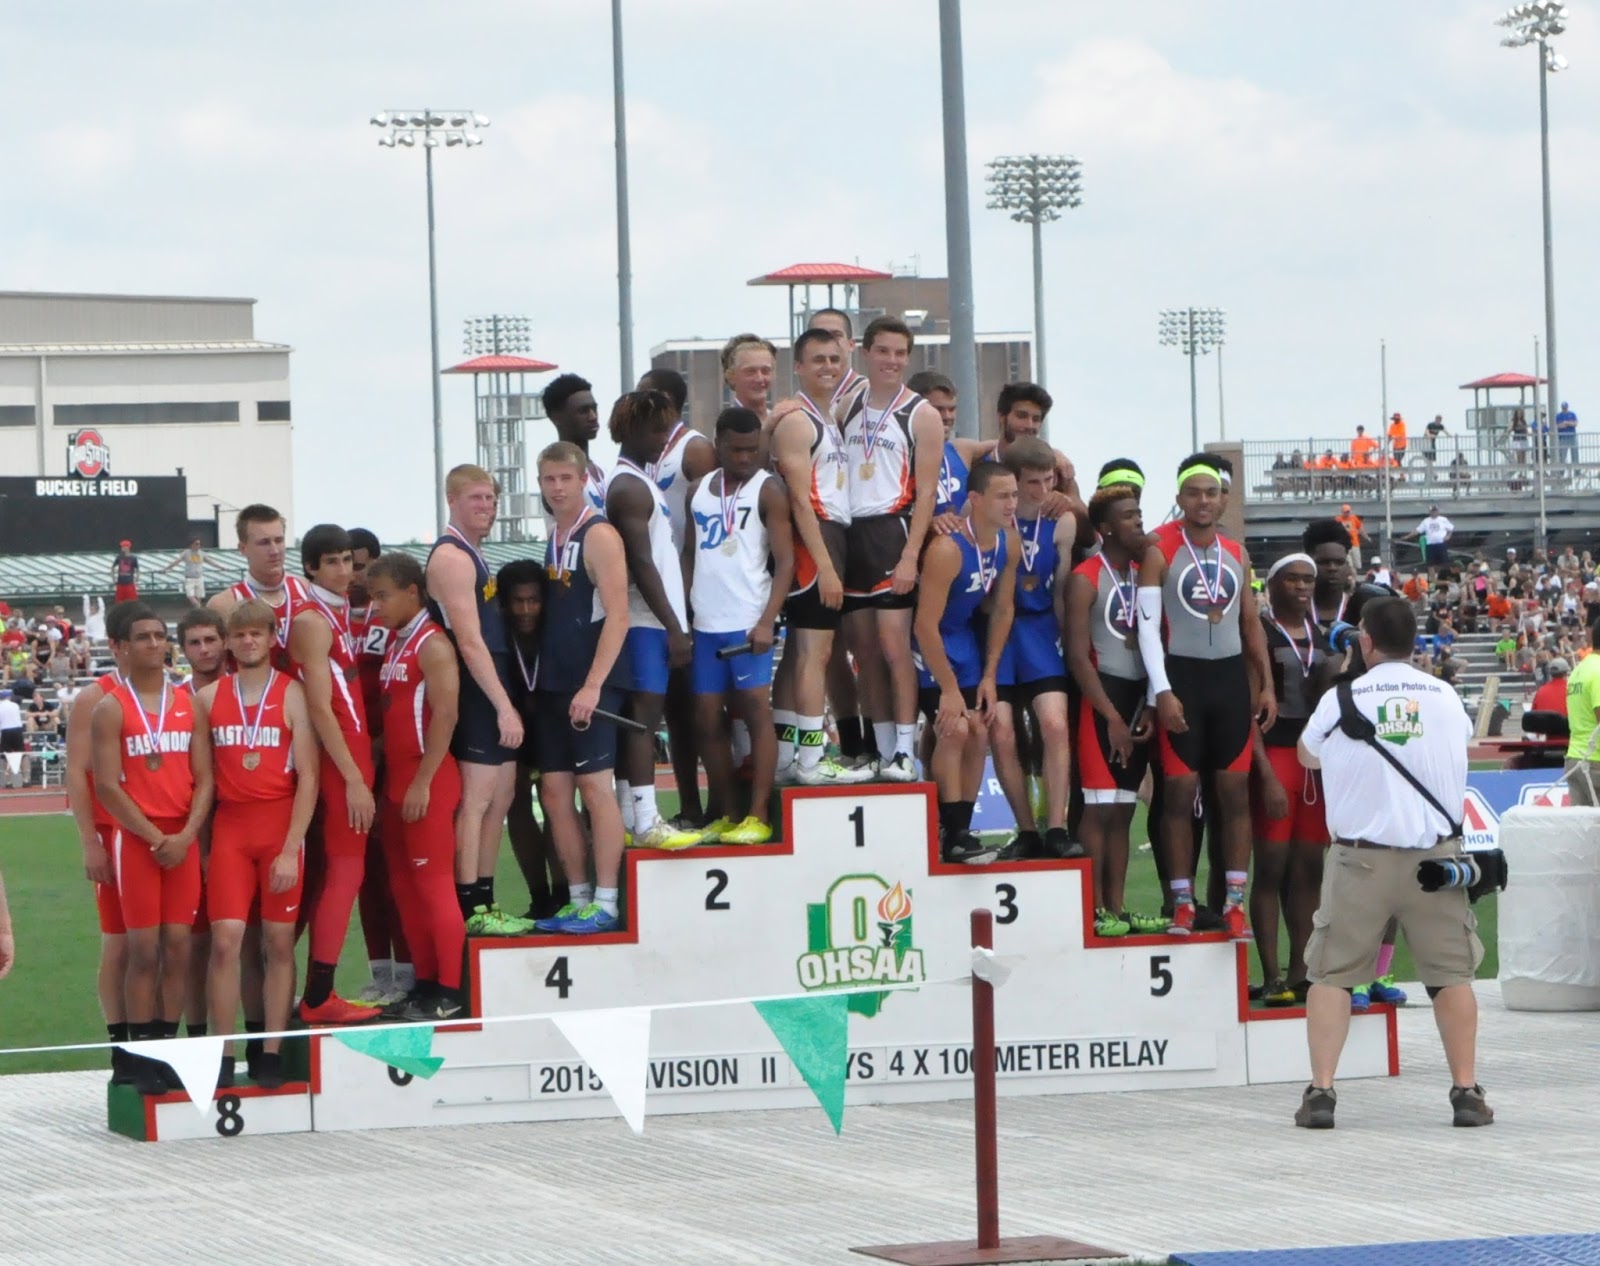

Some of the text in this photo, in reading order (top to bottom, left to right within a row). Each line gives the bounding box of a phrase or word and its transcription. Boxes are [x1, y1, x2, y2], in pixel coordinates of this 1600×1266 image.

[36, 480, 138, 496] BUCKEYE FIELD
[737, 506, 752, 530] 7
[367, 628, 384, 652] 2
[1352, 685, 1374, 696] mpact
[1376, 683, 1399, 692] Action
[1375, 720, 1423, 737] OHSAA
[848, 806, 865, 847] 1
[705, 869, 730, 910] 2
[994, 884, 1019, 924] 3
[545, 956, 573, 999] 4
[798, 946, 925, 988] OHSAA
[1150, 955, 1173, 997] 5
[540, 1065, 603, 1093] 2015
[890, 1050, 904, 1076] 4
[913, 1049, 929, 1076] X
[939, 1048, 975, 1075] 10
[995, 1043, 1080, 1072] METER
[1090, 1039, 1169, 1069] RELAY
[216, 1094, 244, 1137] 8
